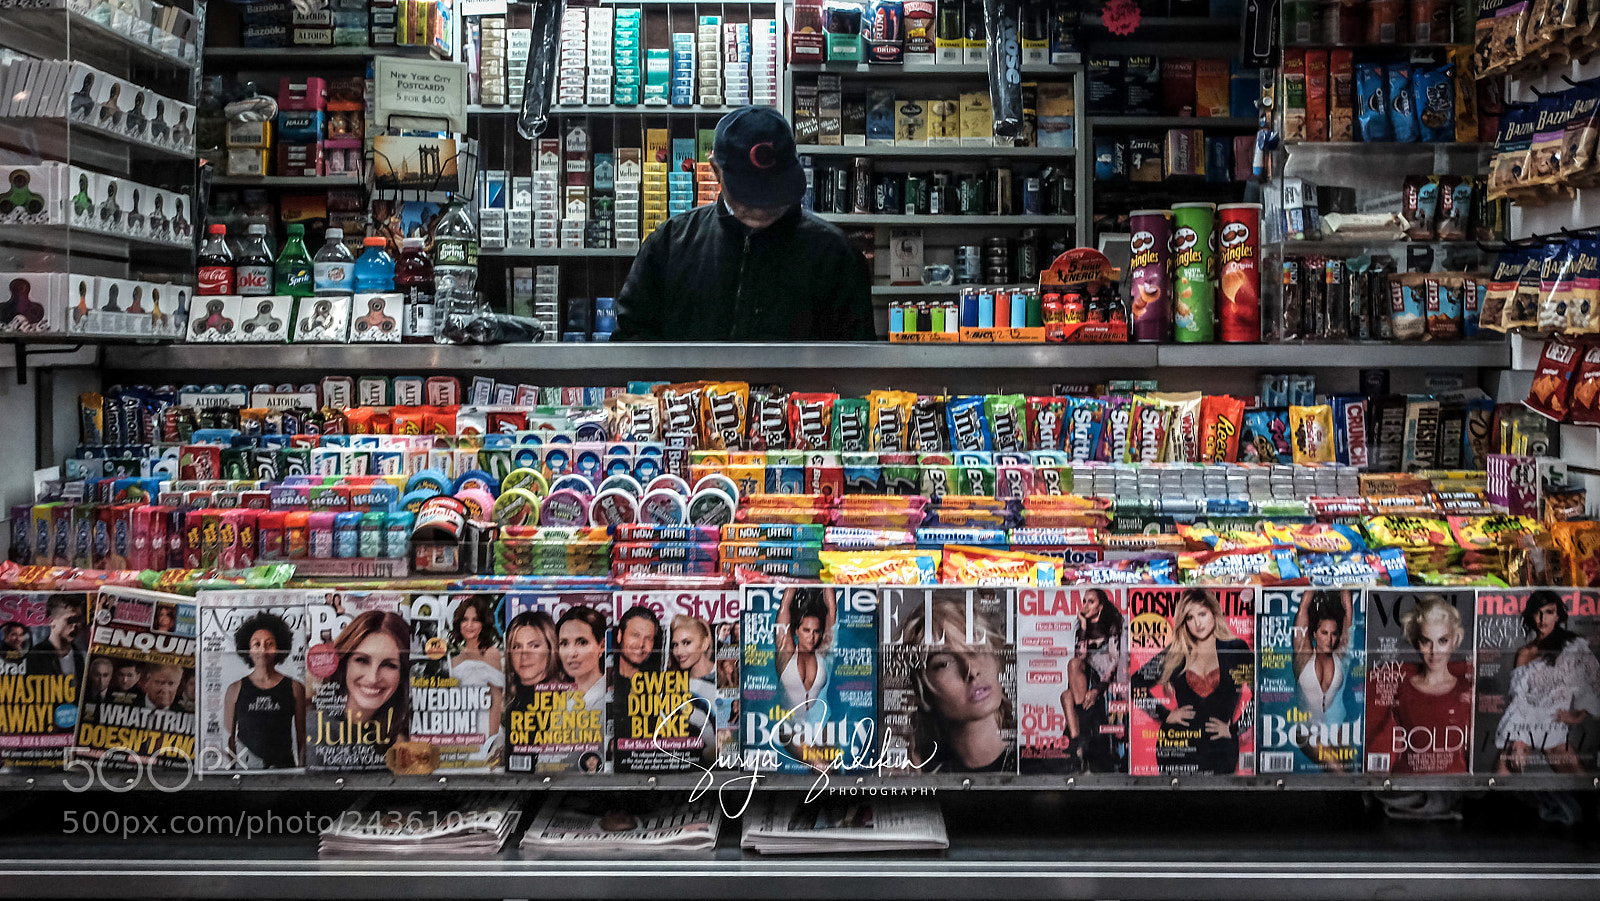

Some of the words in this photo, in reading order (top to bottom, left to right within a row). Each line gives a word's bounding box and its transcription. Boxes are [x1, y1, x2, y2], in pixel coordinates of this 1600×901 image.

[247, 26, 286, 36] Bazooka
[298, 31, 329, 40] ALTOIDS
[397, 80, 445, 92] POSTCARDS
[396, 92, 402, 101] 5
[422, 94, 446, 105] $4.00
[286, 119, 309, 127] HALLS
[796, 118, 818, 130] Black
[802, 125, 819, 136] Mild
[1129, 140, 1161, 150] Zantac
[749, 142, 776, 169] C
[439, 249, 466, 261] Spring
[1221, 243, 1253, 265] Pringles
[1130, 250, 1159, 271] Pringles
[1064, 271, 1101, 284] ENERGY
[1133, 270, 1145, 278] BBQ
[287, 274, 311, 287] Sprite
[1061, 385, 1089, 393] HALLS
[196, 397, 230, 407] ALTOIDS
[267, 397, 301, 407] ALTOIDS
[1304, 414, 1317, 459] Raisinets
[1347, 404, 1366, 467] CRUNCH
[633, 530, 655, 539] NOW
[661, 530, 686, 538] LATER
[738, 527, 761, 538] NOW
[767, 527, 792, 538] LATER
[923, 532, 974, 541] mentos
[632, 548, 654, 558] NOW
[660, 548, 686, 557] LATER
[738, 547, 760, 558] NOW
[766, 547, 791, 557] LATER
[629, 563, 651, 573] NOW
[657, 563, 683, 574] LATER
[763, 563, 789, 574] LATER
[616, 594, 664, 626] Life
[677, 593, 740, 625] Style
[745, 613, 772, 624] BEST
[1261, 616, 1290, 626] BEST
[745, 623, 790, 635] BEAUTY
[1130, 621, 1168, 635] OMG
[1261, 626, 1309, 637] BEAUTY
[745, 634, 774, 645] BUYS
[1131, 635, 1167, 649] SEX!
[1261, 636, 1292, 648] BUYS
[745, 651, 774, 660] GENIUS
[844, 657, 872, 666] STYLE
[1261, 655, 1292, 663] GENIUS
[745, 658, 769, 666] PICKS
[1261, 661, 1286, 669] PICKS
[1373, 660, 1405, 673] KATY
[631, 671, 690, 695] GWEN
[1027, 671, 1063, 683] Lovers
[1369, 671, 1407, 683] PERRY
[0, 674, 76, 703] WASTING
[1261, 685, 1294, 693] Fabulous
[410, 687, 492, 712] WEDDING
[527, 690, 586, 712] JEN'S
[628, 692, 694, 718] DUMPS
[99, 702, 150, 728] WHAT
[769, 705, 796, 721] the
[1022, 704, 1044, 715] This
[1046, 704, 1056, 714] Is
[1286, 706, 1313, 723] the
[0, 703, 54, 734] AWAY!
[410, 710, 478, 735] ALBUM!
[511, 710, 602, 732] REVENGE
[1021, 714, 1066, 732] OUR
[307, 707, 395, 746] Julia!
[631, 714, 690, 739] BLAKE
[1100, 725, 1125, 734] Leaders
[79, 723, 162, 755] DOESN'T
[510, 730, 530, 746] ON
[533, 730, 603, 745] ANGELINA
[746, 711, 874, 757] Beauty
[1142, 729, 1166, 739] Birth
[1167, 729, 1202, 739] Control
[1392, 725, 1469, 754] BOLD!
[1021, 731, 1071, 750] Time
[1158, 738, 1189, 748] Threat
[802, 744, 845, 762] issue
[1318, 744, 1359, 762] issue
